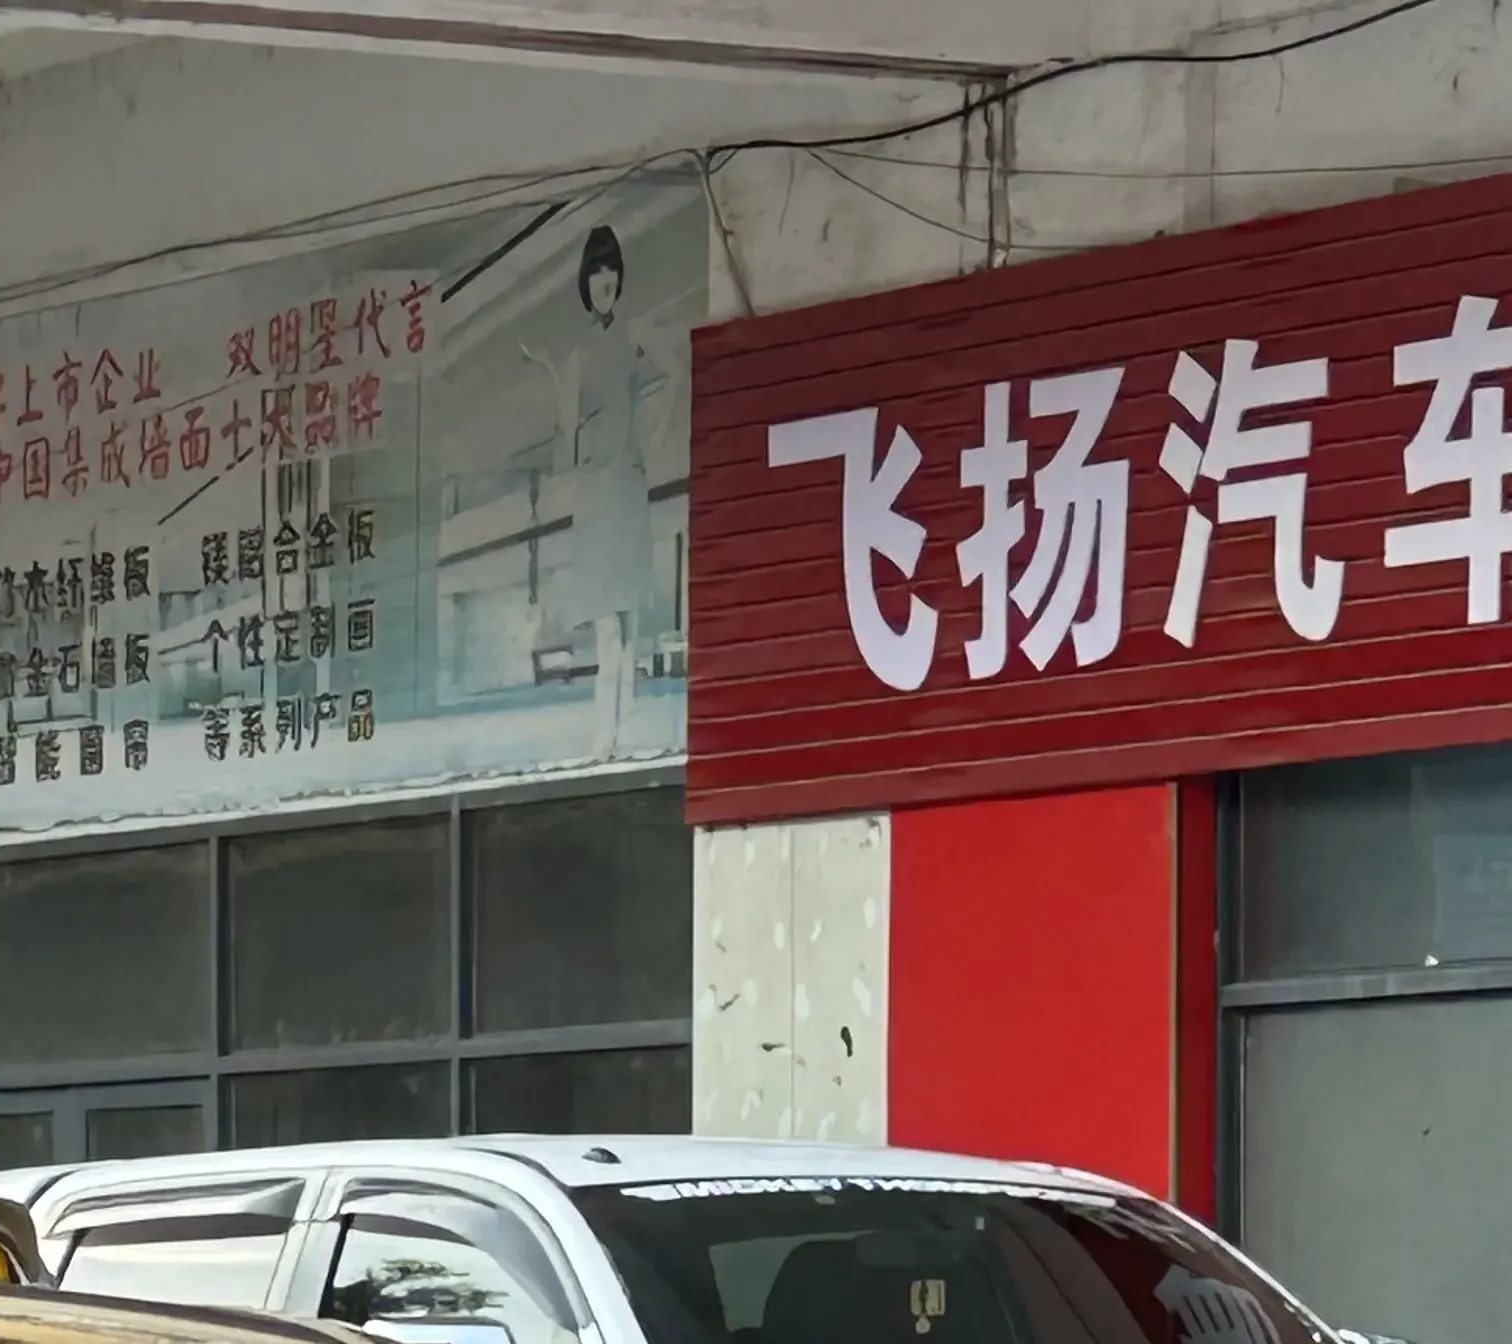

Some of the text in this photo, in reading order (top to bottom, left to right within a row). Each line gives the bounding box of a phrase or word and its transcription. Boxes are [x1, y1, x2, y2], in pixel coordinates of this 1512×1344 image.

[227, 279, 432, 378] 双明星代言
[768, 294, 1512, 691] 飞扬汽车
